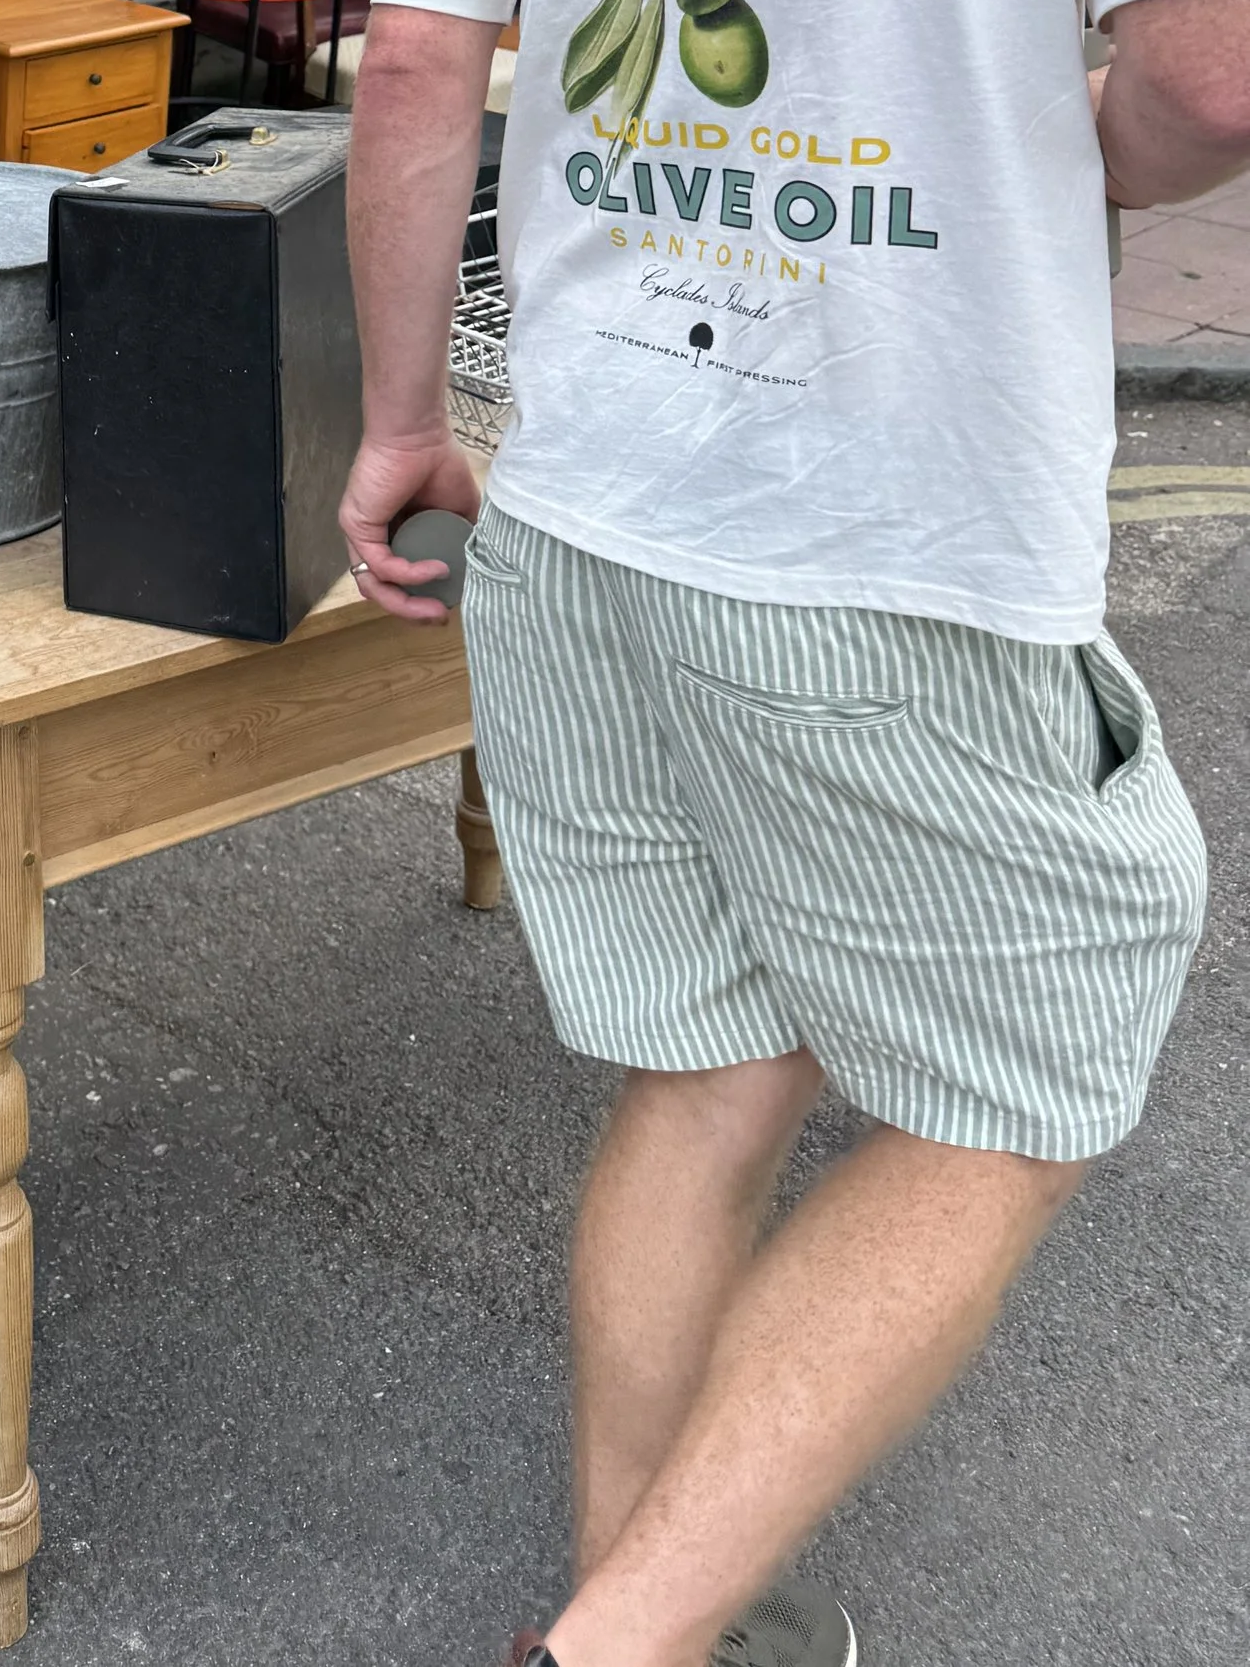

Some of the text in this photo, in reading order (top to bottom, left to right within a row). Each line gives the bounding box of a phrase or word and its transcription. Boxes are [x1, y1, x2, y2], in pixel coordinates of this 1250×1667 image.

[591, 113, 891, 166] LIQUID GOLD
[565, 150, 939, 250] OLIVE OIL
[610, 226, 826, 284] SANTORINI
[639, 263, 769, 321] Cyclades Islands
